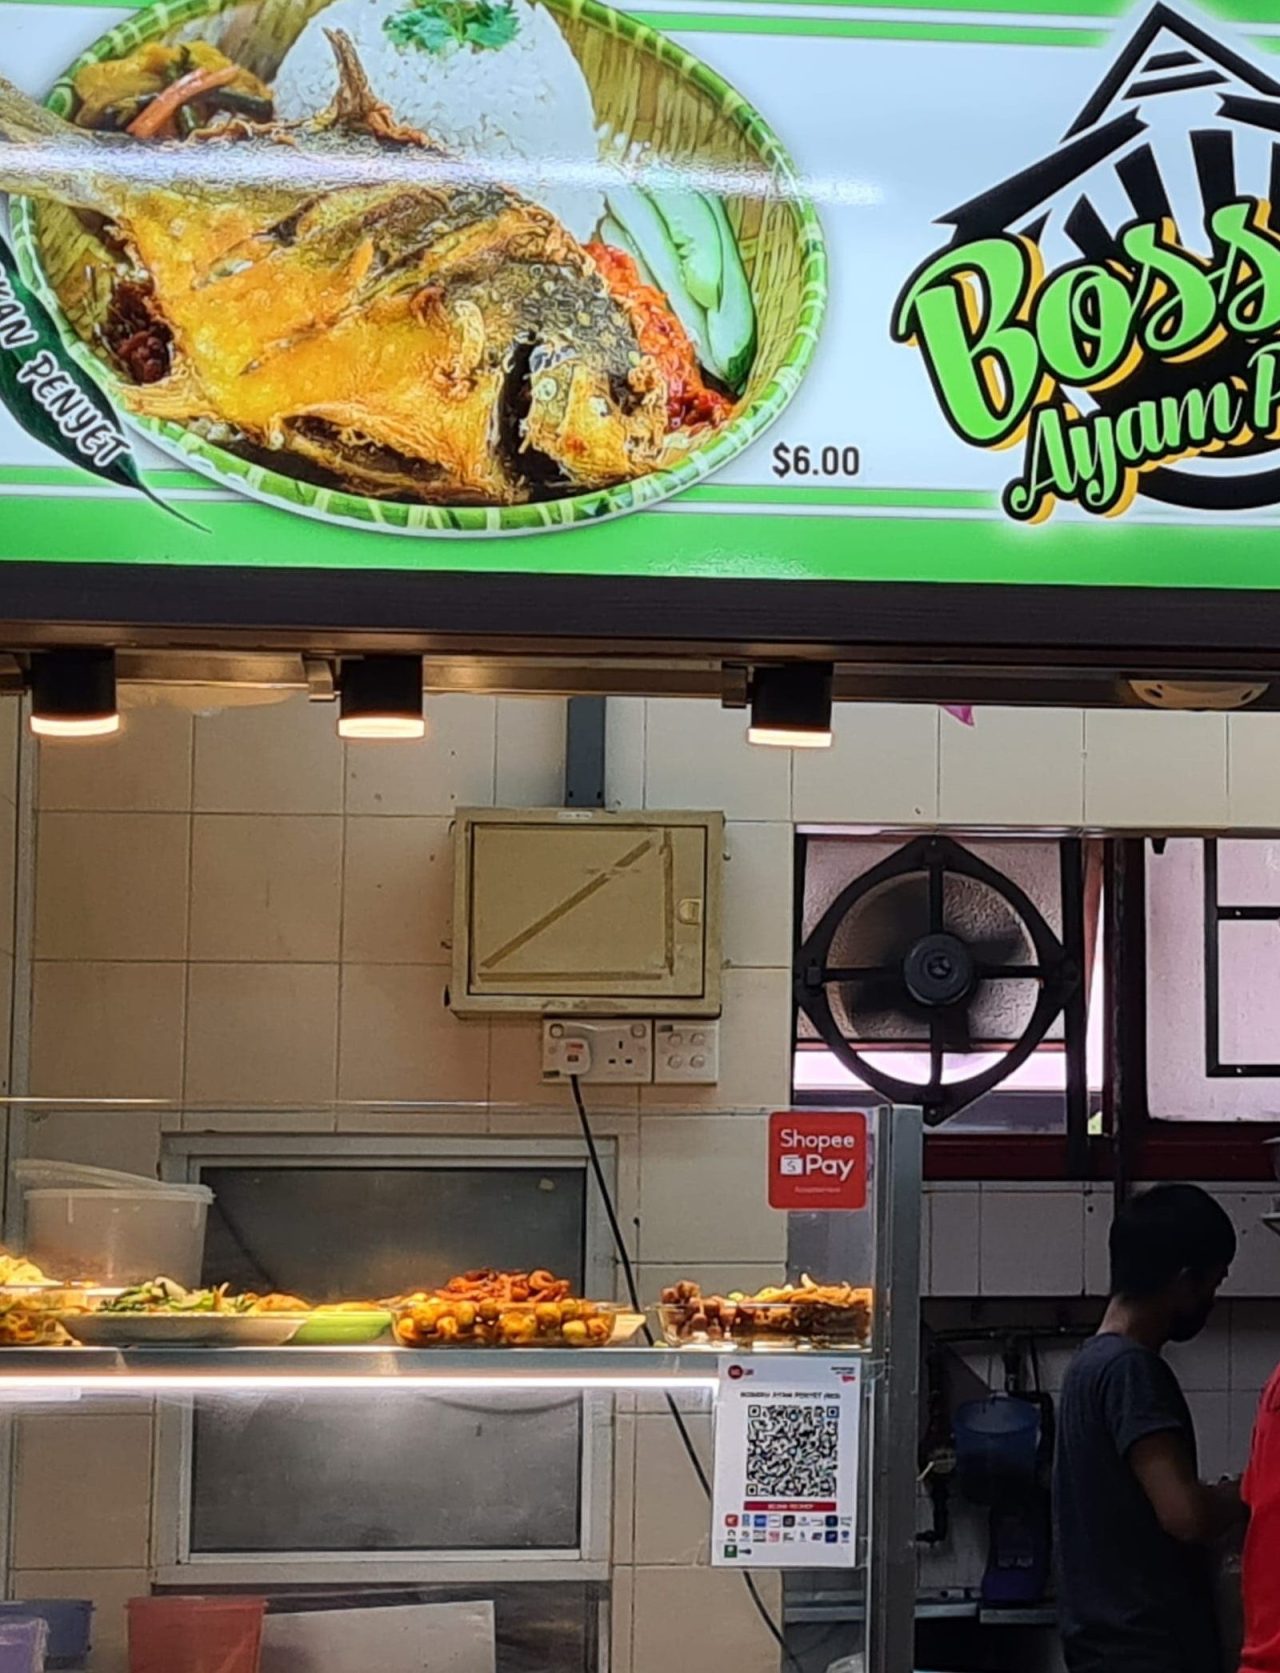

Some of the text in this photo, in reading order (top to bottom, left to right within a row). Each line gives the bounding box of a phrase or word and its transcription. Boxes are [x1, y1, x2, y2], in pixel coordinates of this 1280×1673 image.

[18, 352, 132, 465] PENYET
[772, 442, 860, 478] $6.00
[1005, 374, 1242, 516] Ayam
[780, 1128, 856, 1154] Shopee
[805, 1153, 856, 1182] Pay
